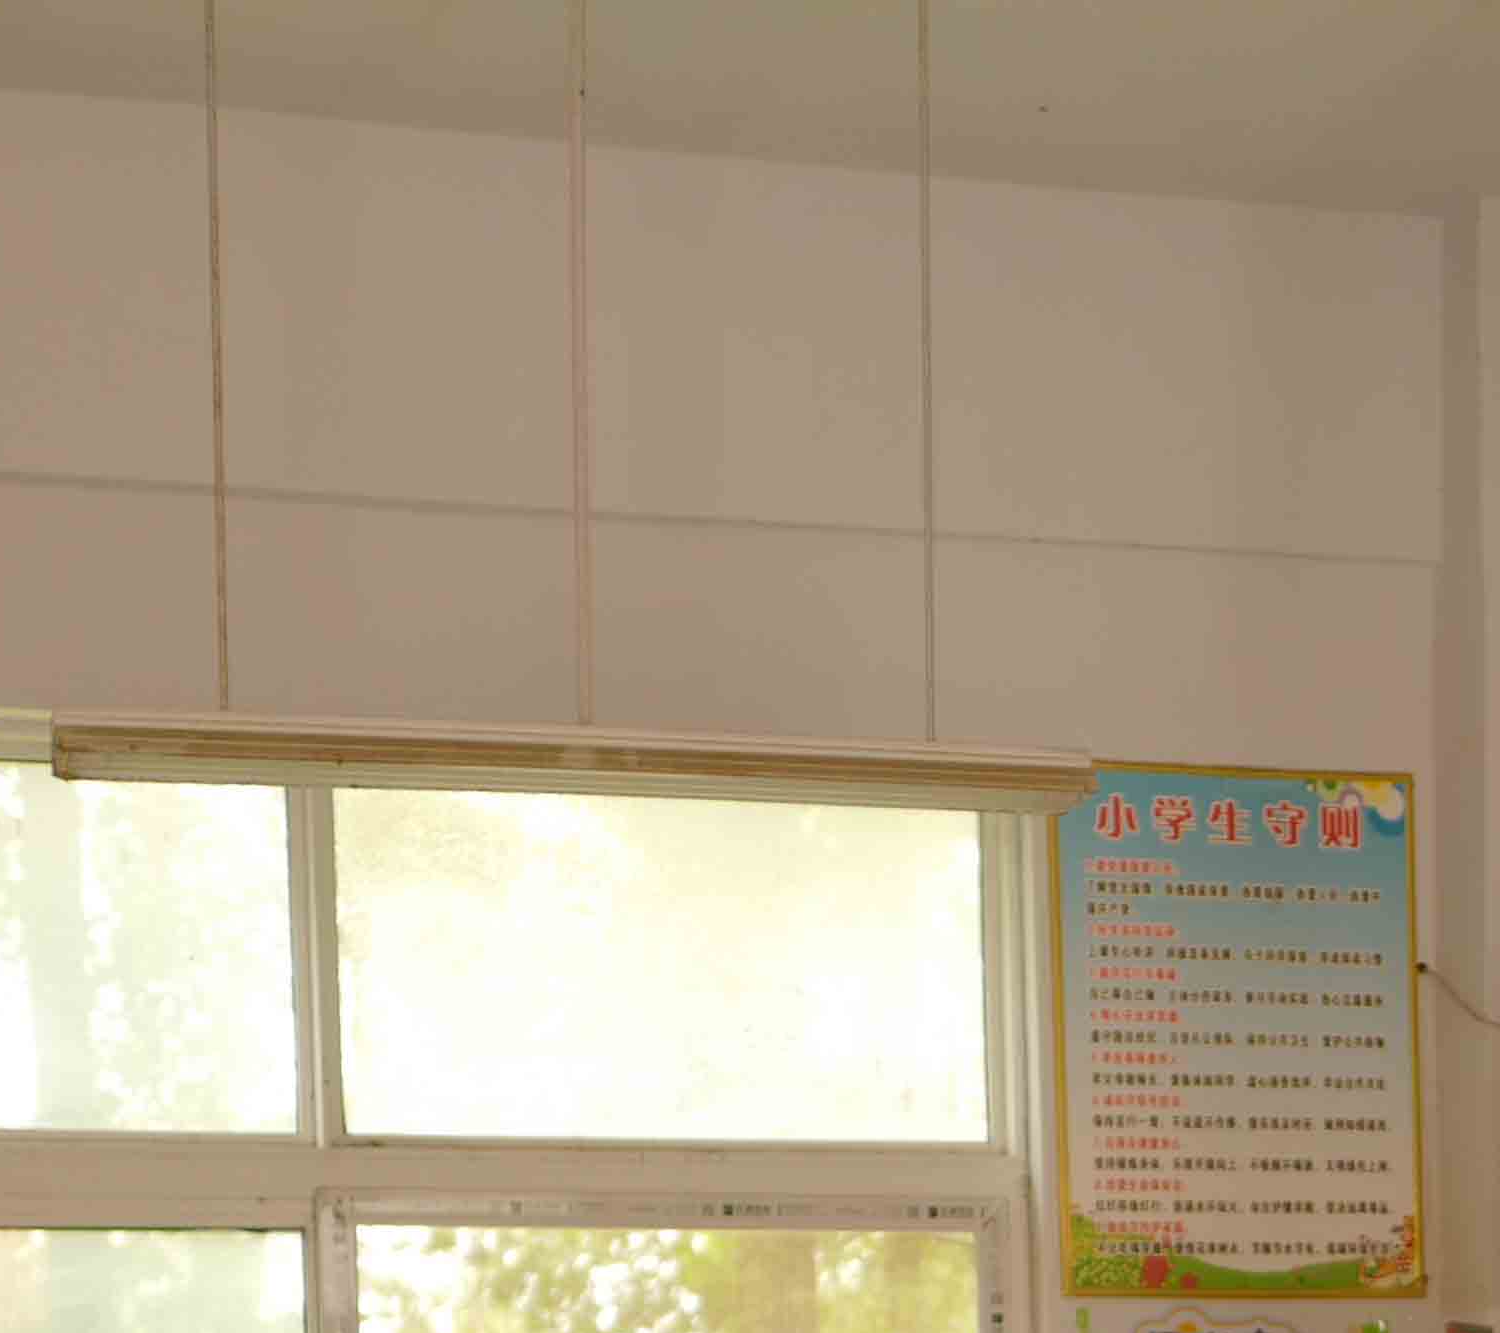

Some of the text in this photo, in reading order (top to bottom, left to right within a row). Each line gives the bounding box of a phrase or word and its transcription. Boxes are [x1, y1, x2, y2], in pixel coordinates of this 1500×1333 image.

[1097, 794, 1364, 849] 小学生守则
